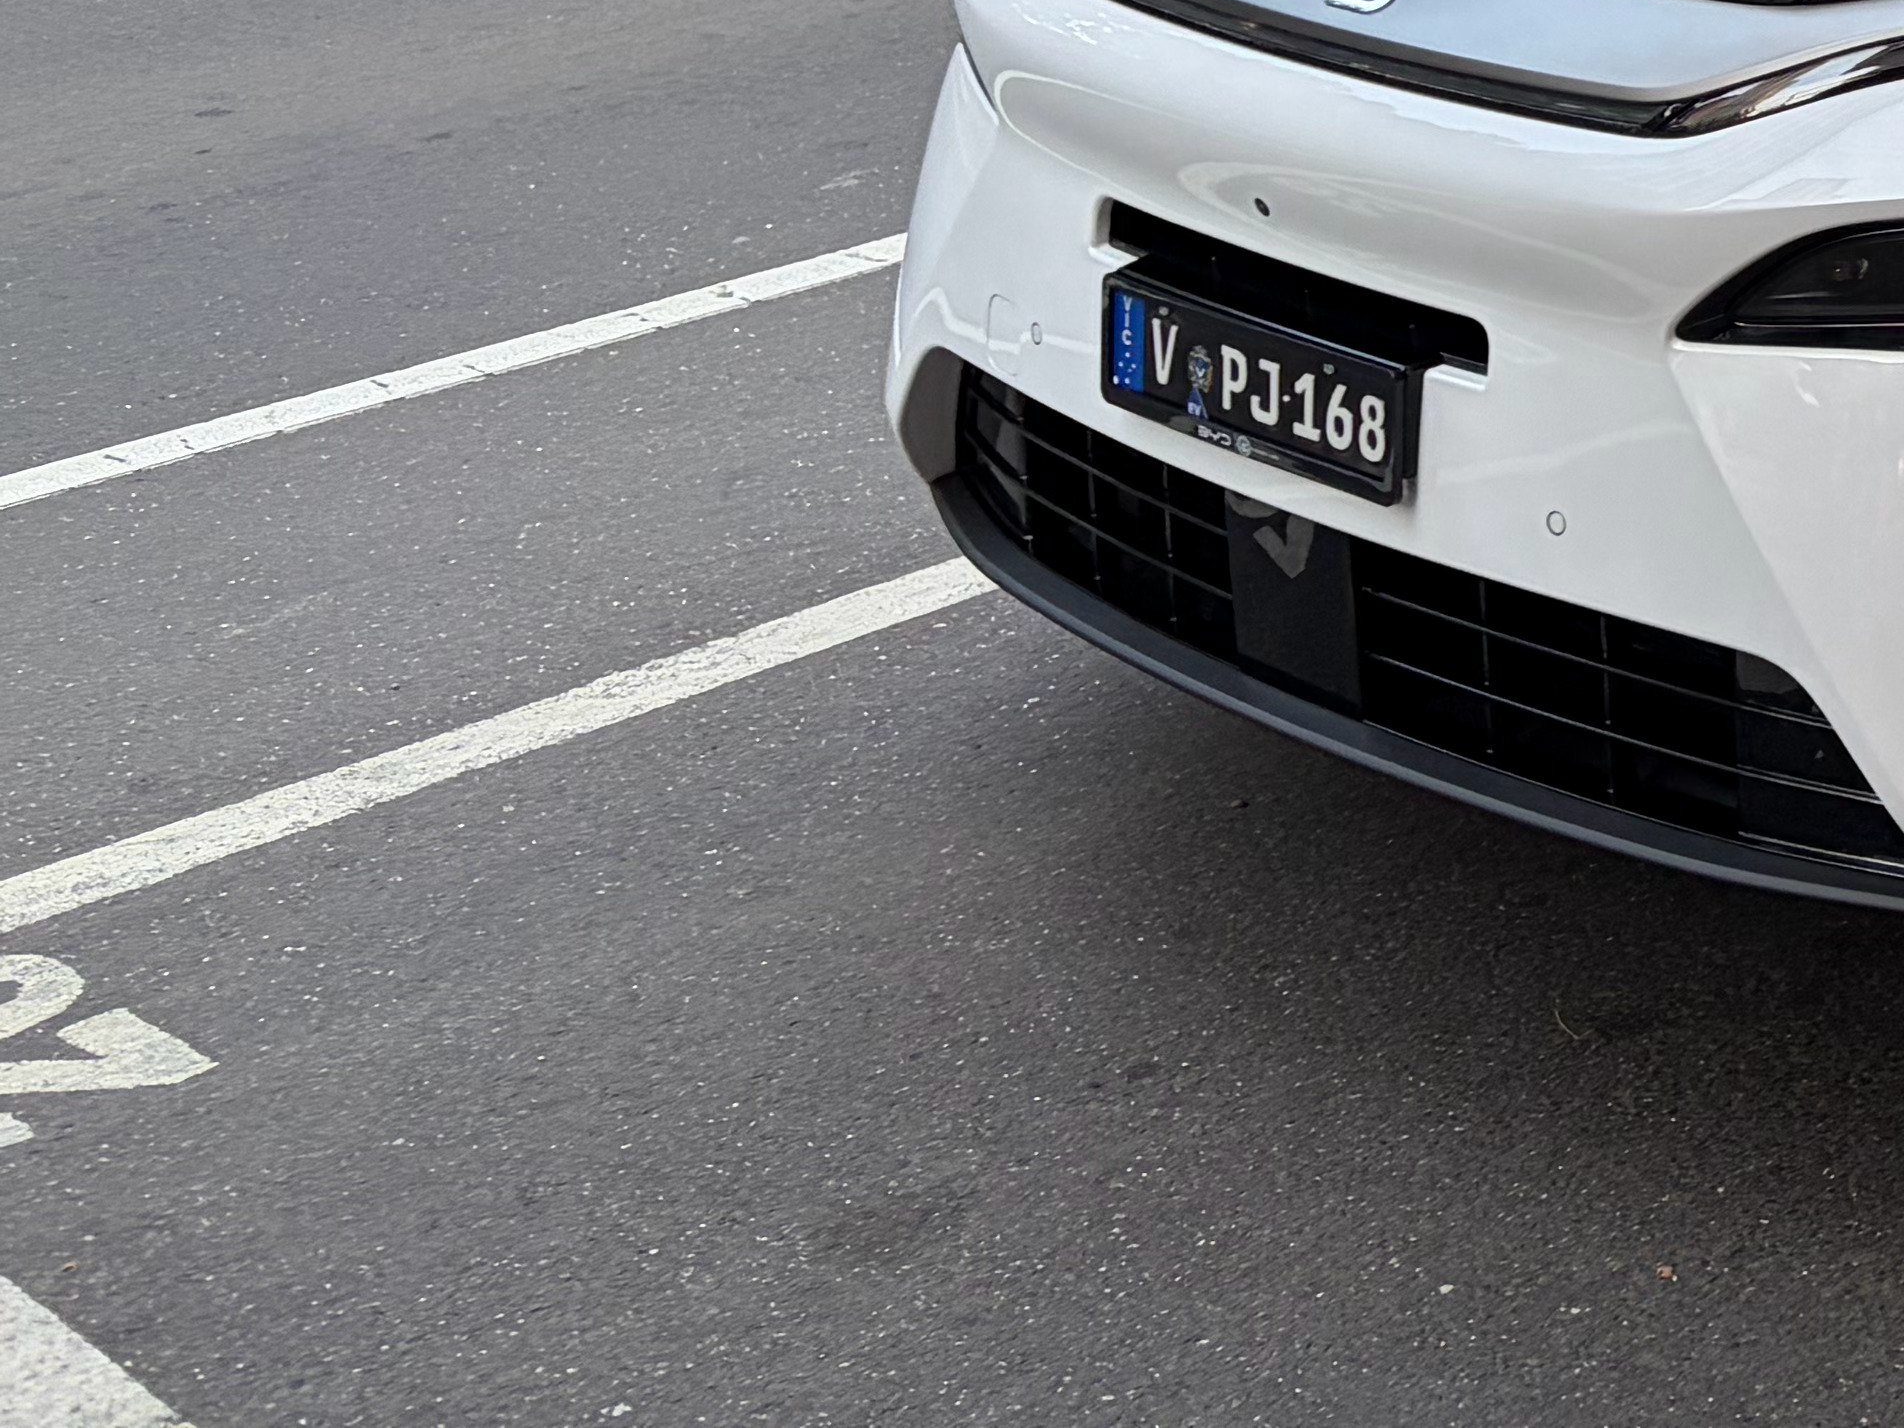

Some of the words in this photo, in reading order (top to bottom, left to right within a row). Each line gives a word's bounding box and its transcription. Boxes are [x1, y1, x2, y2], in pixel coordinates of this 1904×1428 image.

[1121, 296, 1133, 346] VIC
[1151, 317, 1179, 386] V
[1197, 424, 1232, 447] BYD
